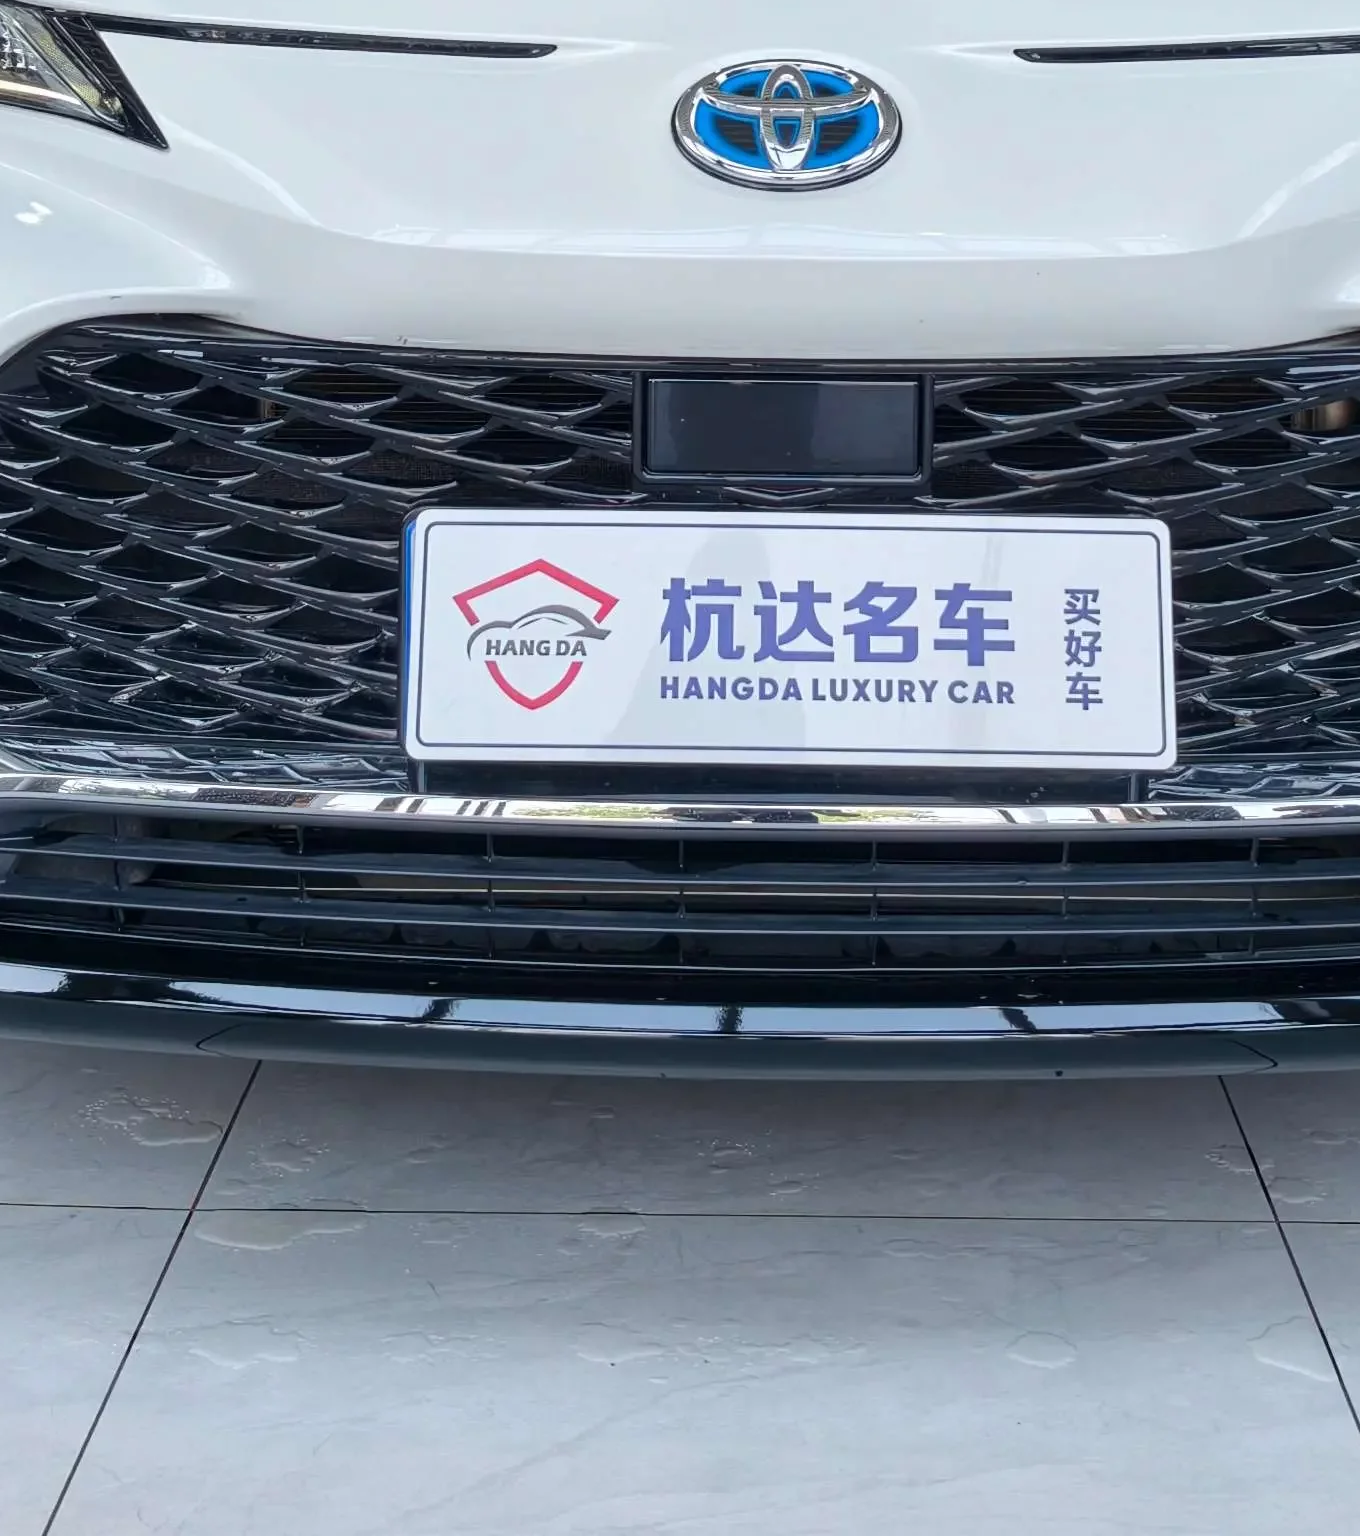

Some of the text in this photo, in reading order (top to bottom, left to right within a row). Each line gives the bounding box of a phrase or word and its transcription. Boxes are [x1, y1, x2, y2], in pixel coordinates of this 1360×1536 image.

[484, 638, 588, 658] HANG DA
[660, 576, 1016, 667] 杭达名车
[1063, 588, 1104, 711] 买好车
[660, 676, 1015, 706] HANGDA LUXURY CAR
